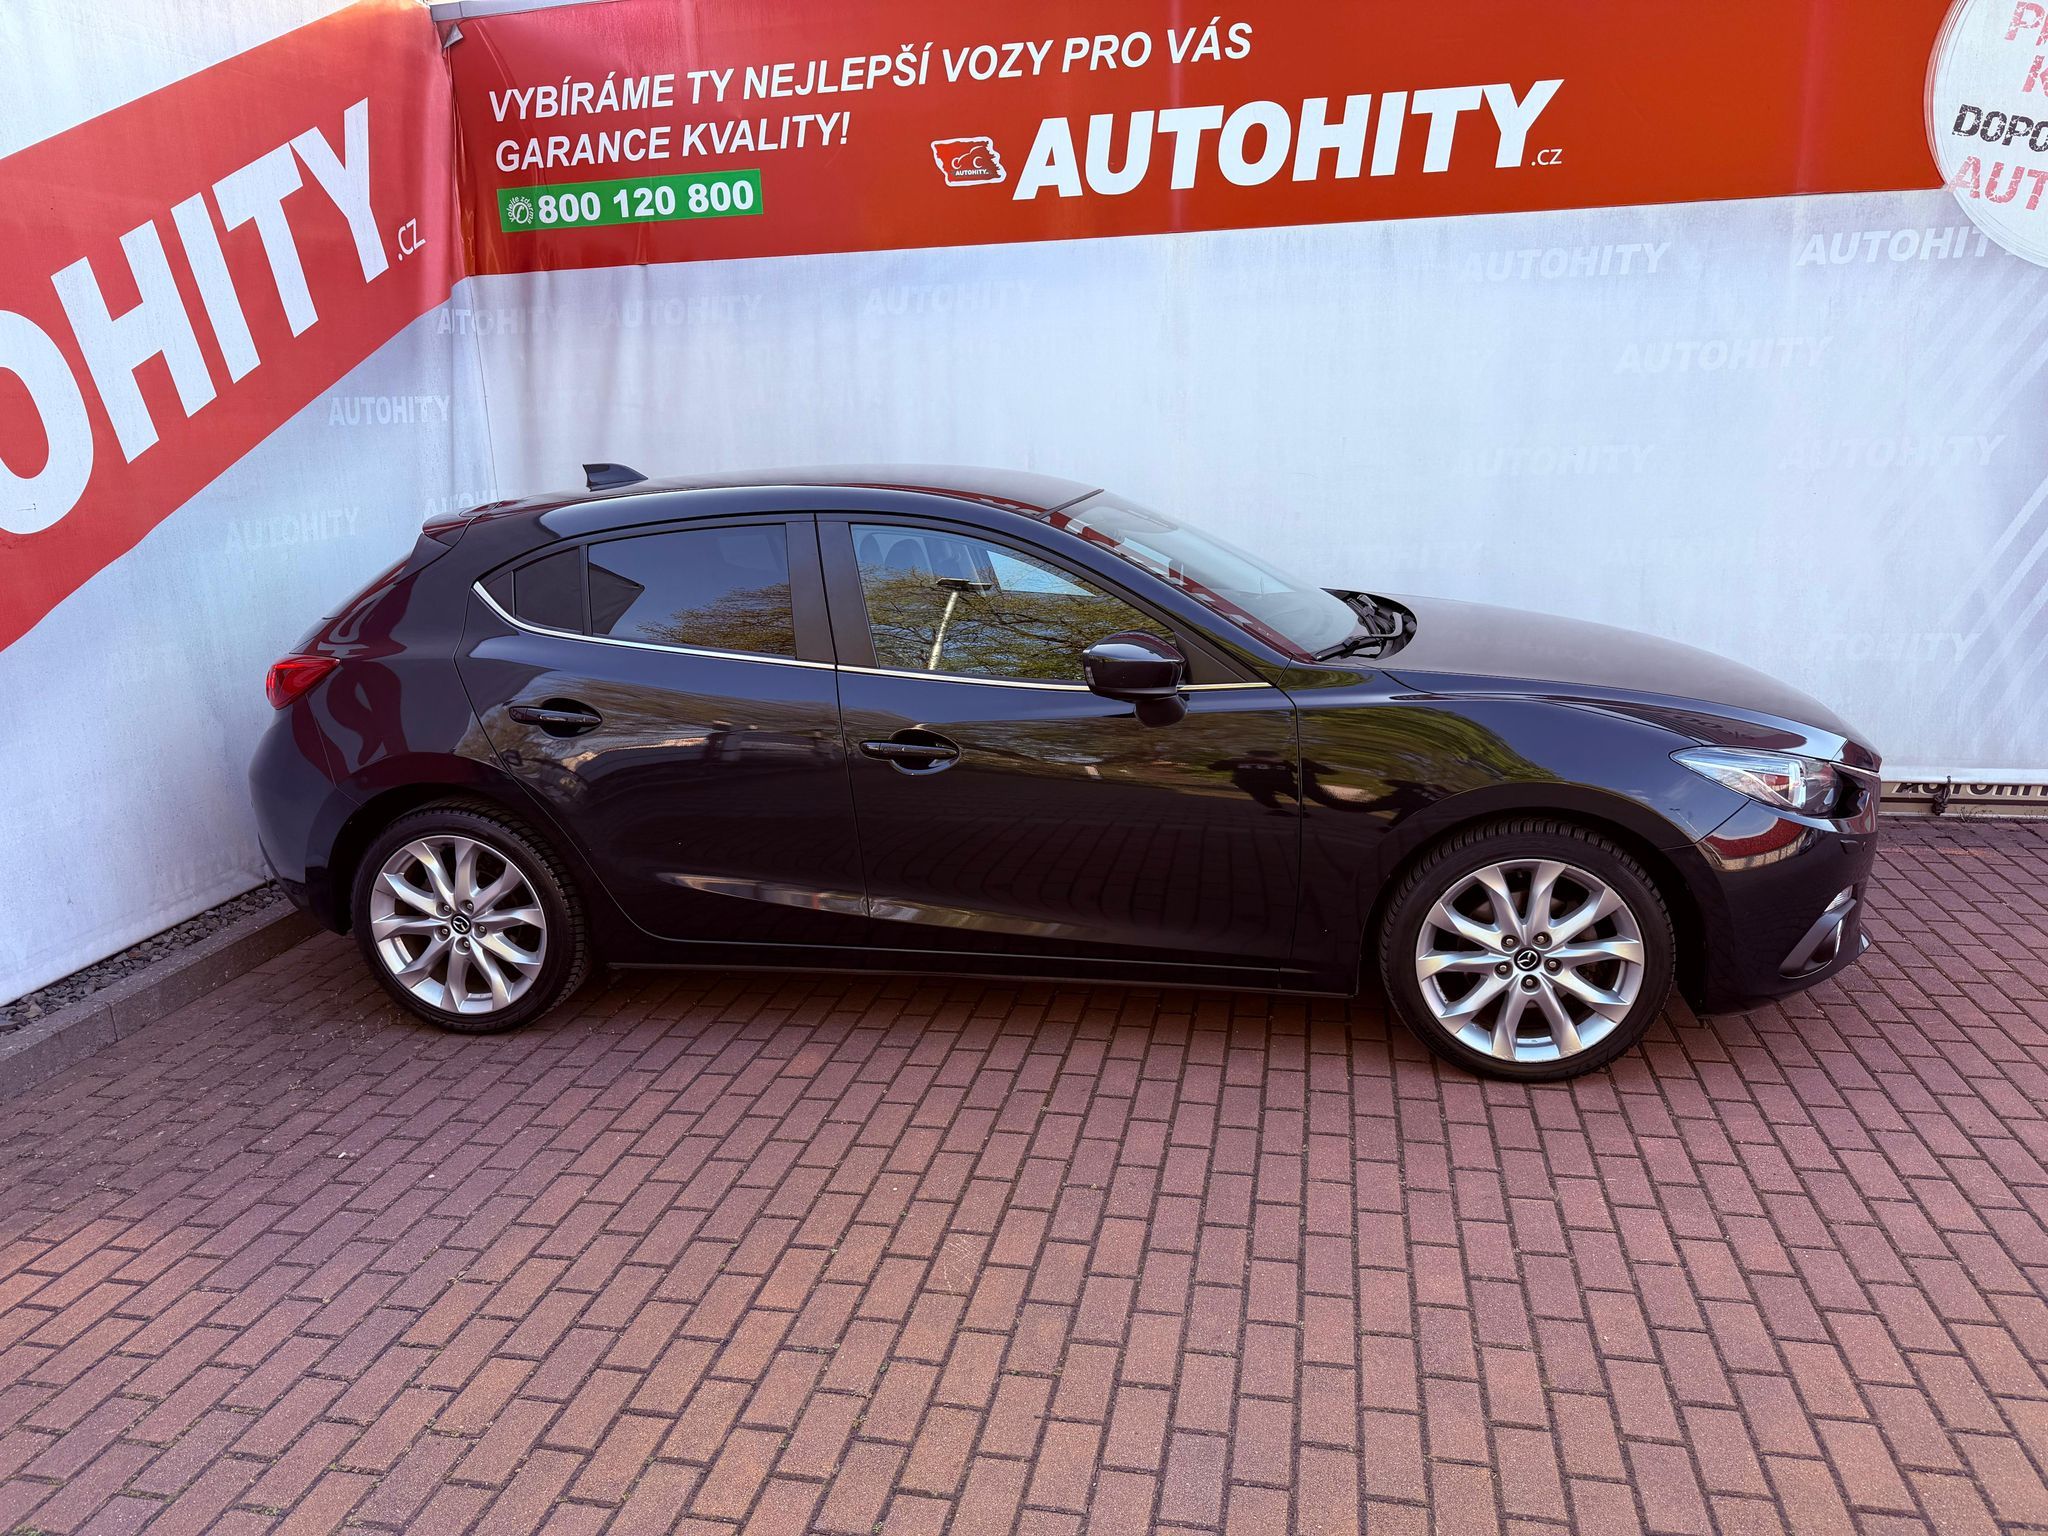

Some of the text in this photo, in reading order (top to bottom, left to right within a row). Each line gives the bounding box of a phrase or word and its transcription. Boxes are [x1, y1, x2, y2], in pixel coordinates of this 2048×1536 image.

[489, 16, 1253, 122] VYBÍRÁME TY NEJLEPŠÍ VOZY PRO VÁS
[496, 111, 851, 172] GARANCE KVALITY!
[1012, 79, 1565, 201] AUTOHITY
[538, 180, 754, 224] 800 120 800
[1458, 242, 1672, 284] AUTOHITY
[1796, 226, 2016, 266] AUTOHIT
[1613, 336, 1833, 375] AUTOHITY
[328, 395, 451, 427] AUTOHITY
